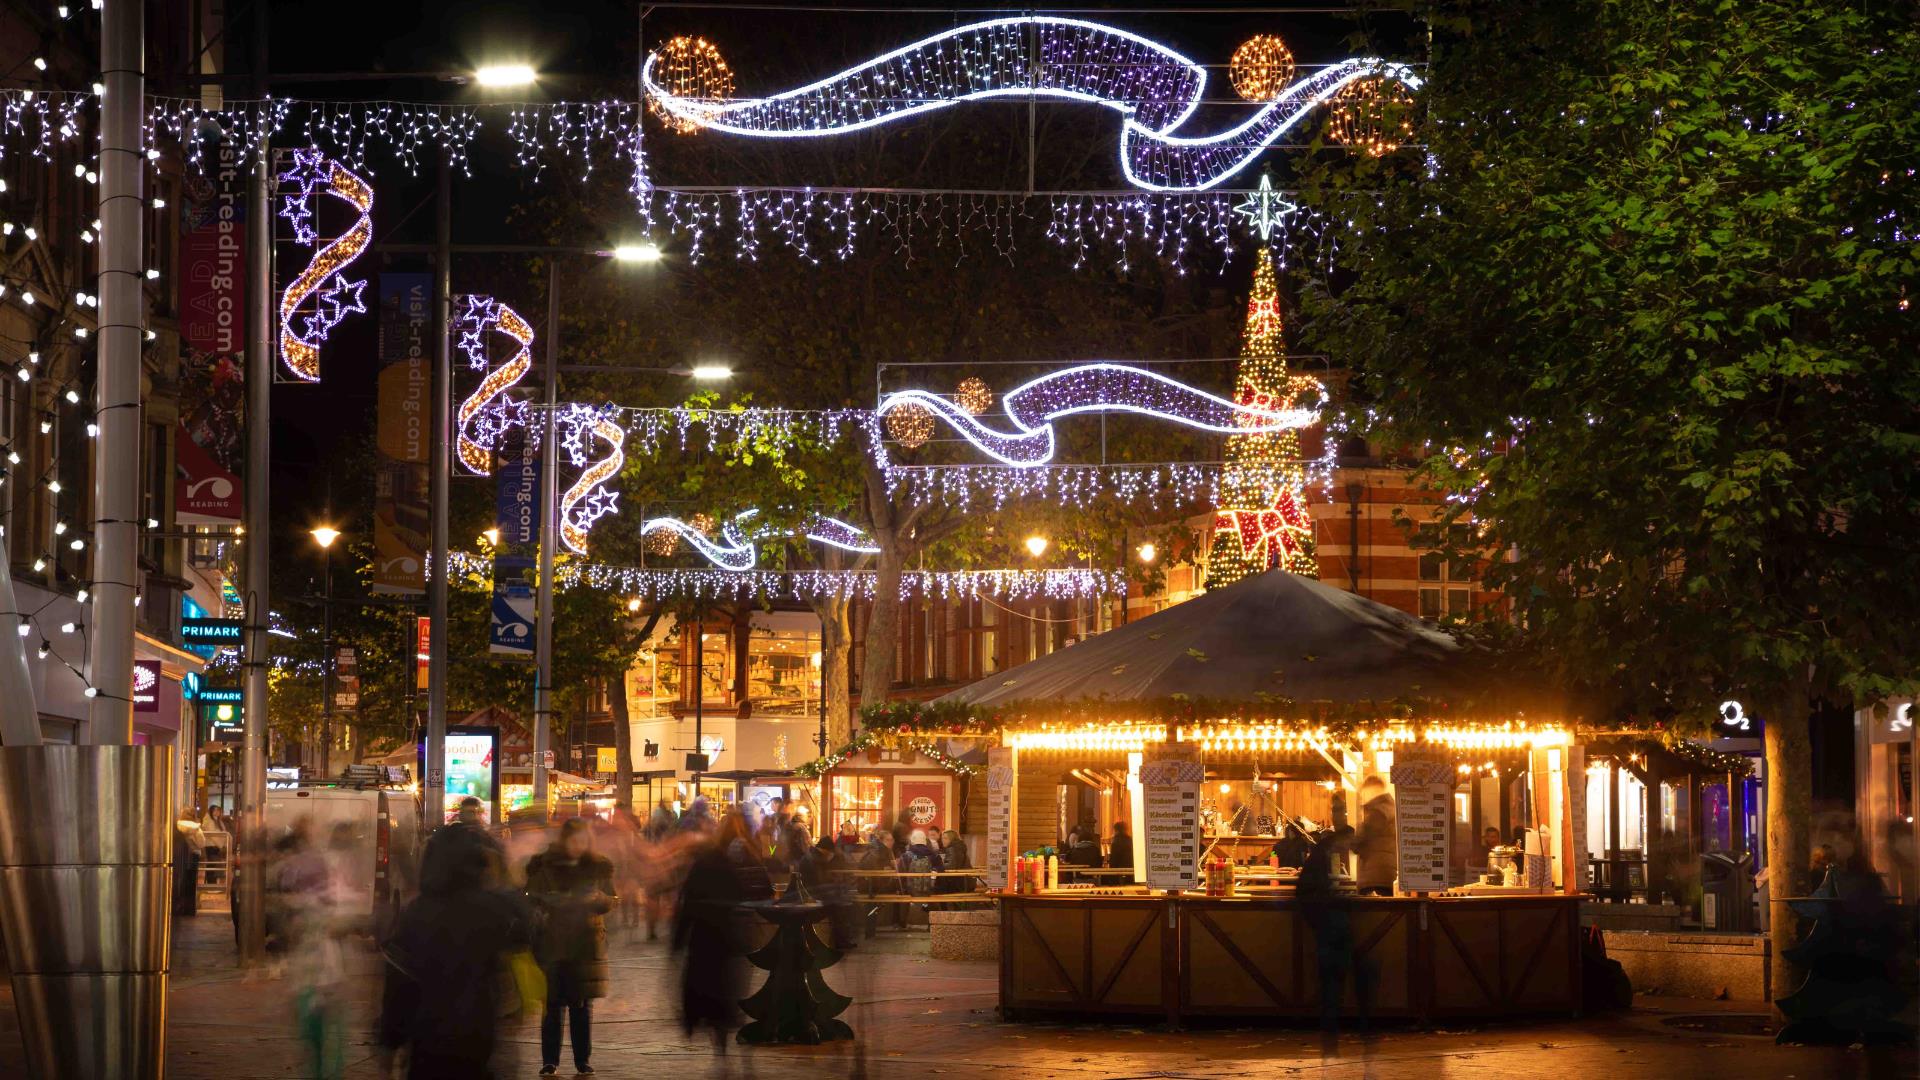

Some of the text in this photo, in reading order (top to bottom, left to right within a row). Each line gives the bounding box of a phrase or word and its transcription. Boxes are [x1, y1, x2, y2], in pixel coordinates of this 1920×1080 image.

[403, 284, 425, 461] visit-reading.com
[189, 500, 230, 508] READING
[182, 626, 240, 637] PRIMARK
[200, 692, 242, 701] PRIMARK
[1719, 700, 1750, 730] O2
